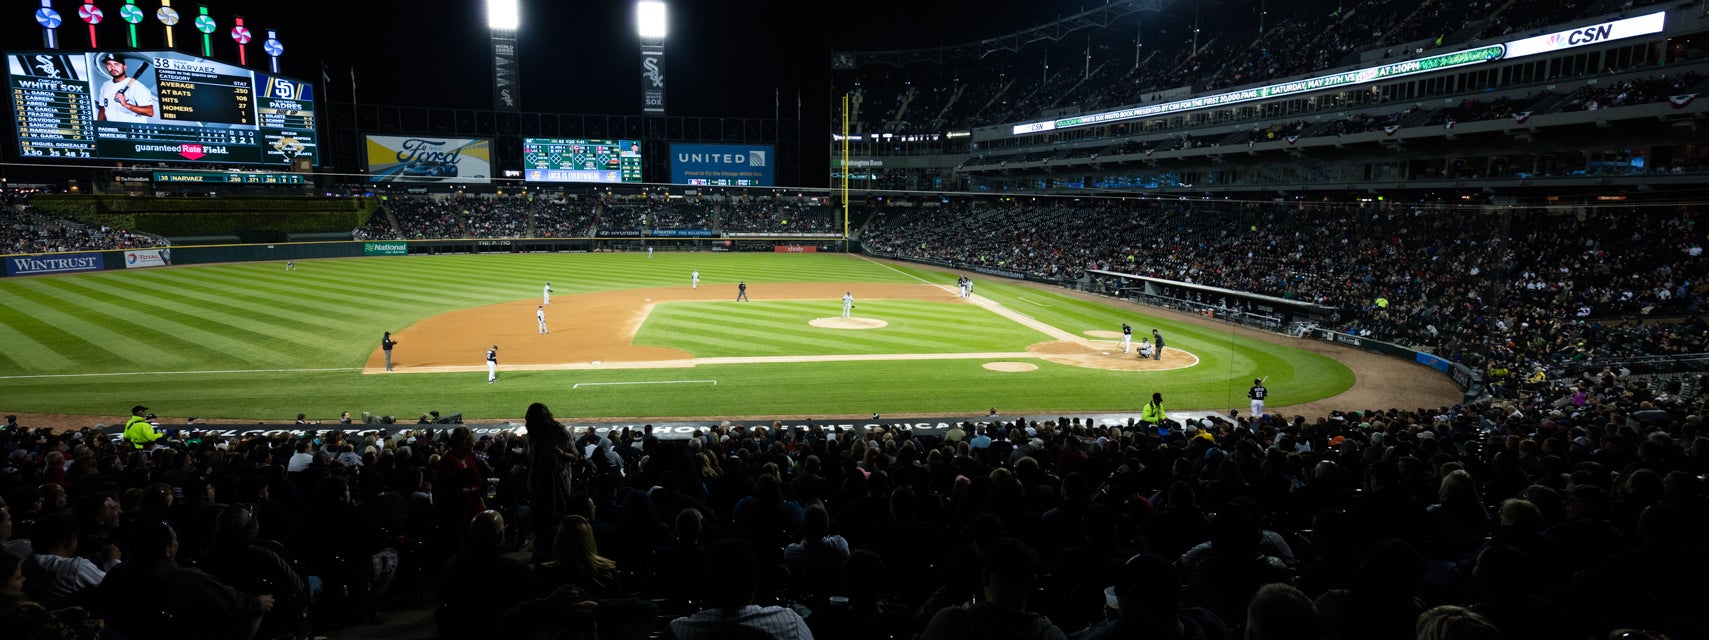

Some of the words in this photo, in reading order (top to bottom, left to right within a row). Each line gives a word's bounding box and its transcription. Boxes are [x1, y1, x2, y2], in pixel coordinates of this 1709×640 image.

[1568, 24, 1613, 46] CSN
[154, 58, 169, 68] 38
[174, 64, 216, 74] NARVAEZ
[1271, 82, 1307, 95] SATURDAY,
[1308, 78, 1324, 88] MAY
[1324, 76, 1343, 86] 27TH
[1379, 67, 1391, 76] AT
[1392, 62, 1420, 74] 1:10PM
[19, 80, 58, 90] WHITE
[160, 81, 195, 90] AVERAGE
[270, 102, 302, 110] PADRES
[1134, 105, 1161, 116] PRESENTED
[1220, 93, 1240, 103] 20,000
[1241, 91, 1257, 99] FANS
[182, 145, 201, 153] Rate
[396, 139, 463, 165] Ford
[679, 153, 745, 163] UNITED
[568, 172, 600, 180] EVERYWHERE
[14, 257, 96, 271] WINTRUST
